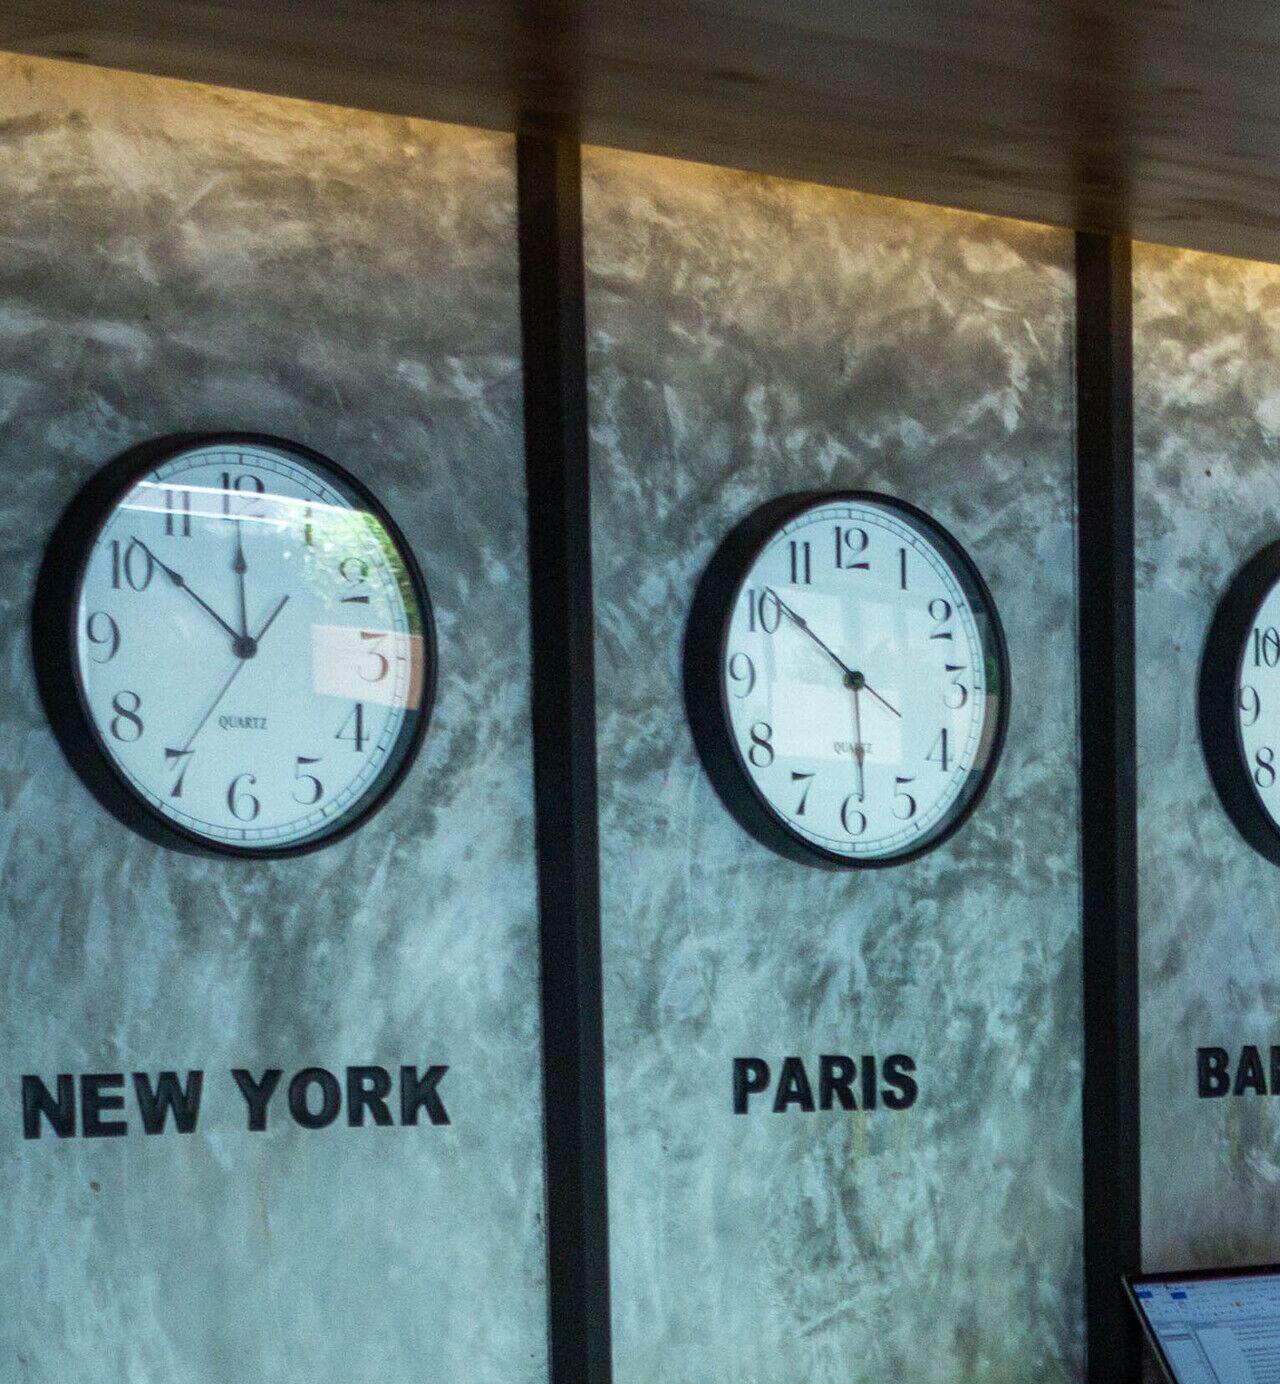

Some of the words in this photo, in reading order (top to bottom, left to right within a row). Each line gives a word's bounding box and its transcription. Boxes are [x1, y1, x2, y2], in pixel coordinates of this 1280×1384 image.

[165, 490, 192, 537] 11
[219, 473, 266, 520] 12
[304, 499, 313, 547] 1
[110, 539, 153, 592] 10
[790, 541, 811, 585] 11
[835, 526, 870, 570] 12
[900, 548, 907, 590] 1
[339, 557, 369, 604] 2
[747, 588, 781, 635] 10
[928, 598, 953, 640] 2
[87, 612, 120, 663] 9
[357, 632, 389, 683] 3
[1254, 627, 1280, 667] 10
[729, 653, 756, 699] 9
[943, 664, 967, 710] 3
[110, 690, 144, 743] 8
[218, 715, 267, 730] QUARTZ
[335, 703, 370, 751] 4
[1239, 685, 1261, 727] 9
[748, 722, 774, 767] 8
[833, 741, 872, 755] QUAZ
[925, 728, 953, 772] 4
[1254, 746, 1276, 788] 8
[164, 748, 194, 797] 7
[292, 756, 324, 805] 5
[792, 772, 816, 816] 7
[227, 774, 260, 822] 6
[841, 794, 867, 836] 6
[894, 778, 916, 820] 5
[21, 1070, 203, 1140] NEW
[230, 1065, 452, 1132] YORK
[732, 1054, 919, 1114] PARIS
